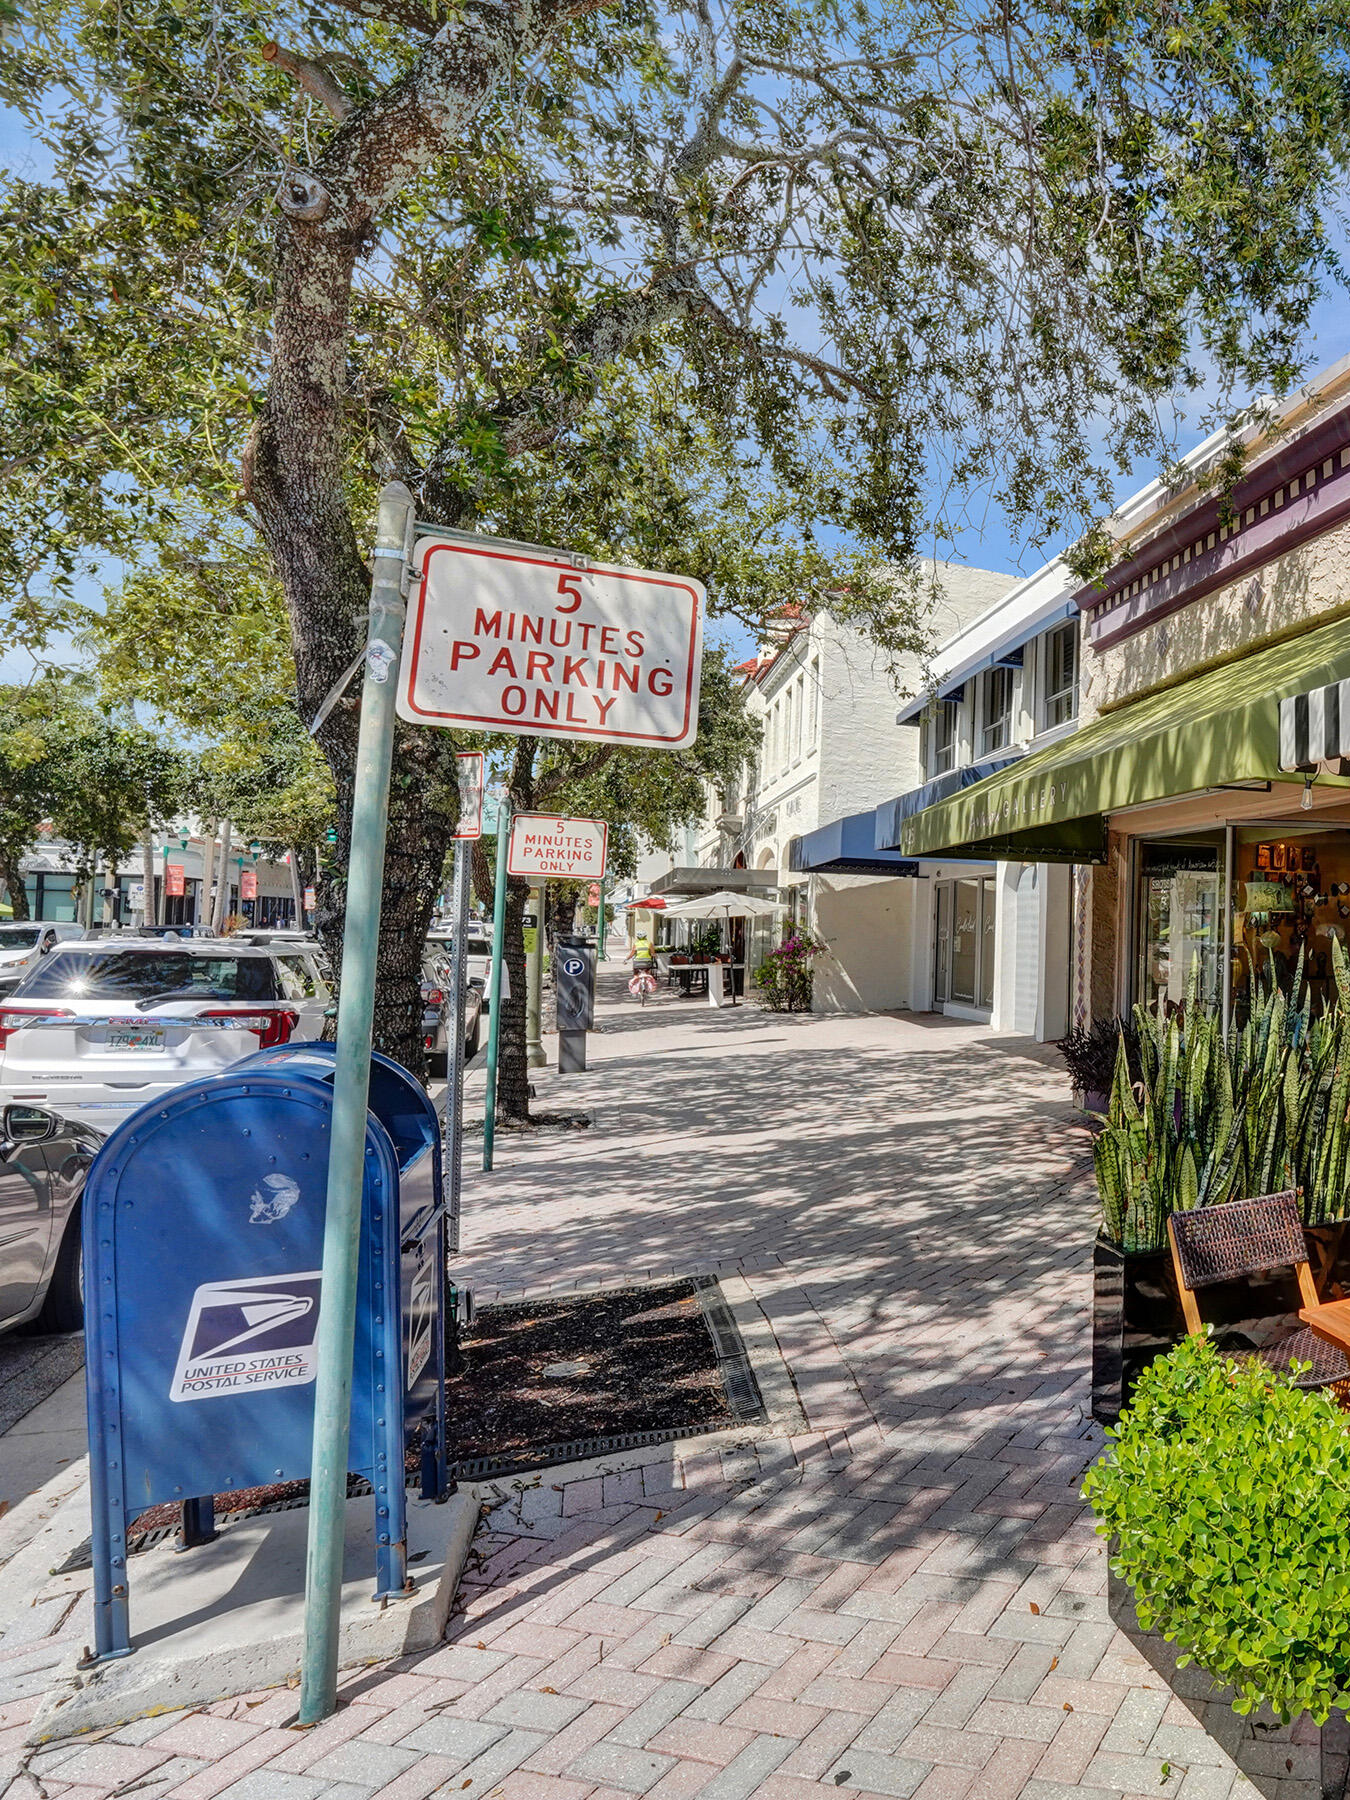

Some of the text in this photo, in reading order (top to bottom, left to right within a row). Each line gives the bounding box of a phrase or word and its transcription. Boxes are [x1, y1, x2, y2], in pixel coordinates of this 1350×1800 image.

[555, 573, 582, 614] 5
[474, 607, 645, 658] MINUTES
[450, 640, 674, 697] PARKING
[501, 685, 617, 726] ONLY
[1002, 782, 1068, 818] GALLERY
[556, 822, 565, 834] 5
[523, 847, 592, 861] PARKING
[525, 834, 593, 849] MINUTES
[540, 861, 574, 872] ONLY
[568, 961, 580, 974] P
[109, 1017, 160, 1025] GMC
[181, 1367, 309, 1393] POSTAL SERVICE
[184, 1354, 303, 1380] UNITED STATES
